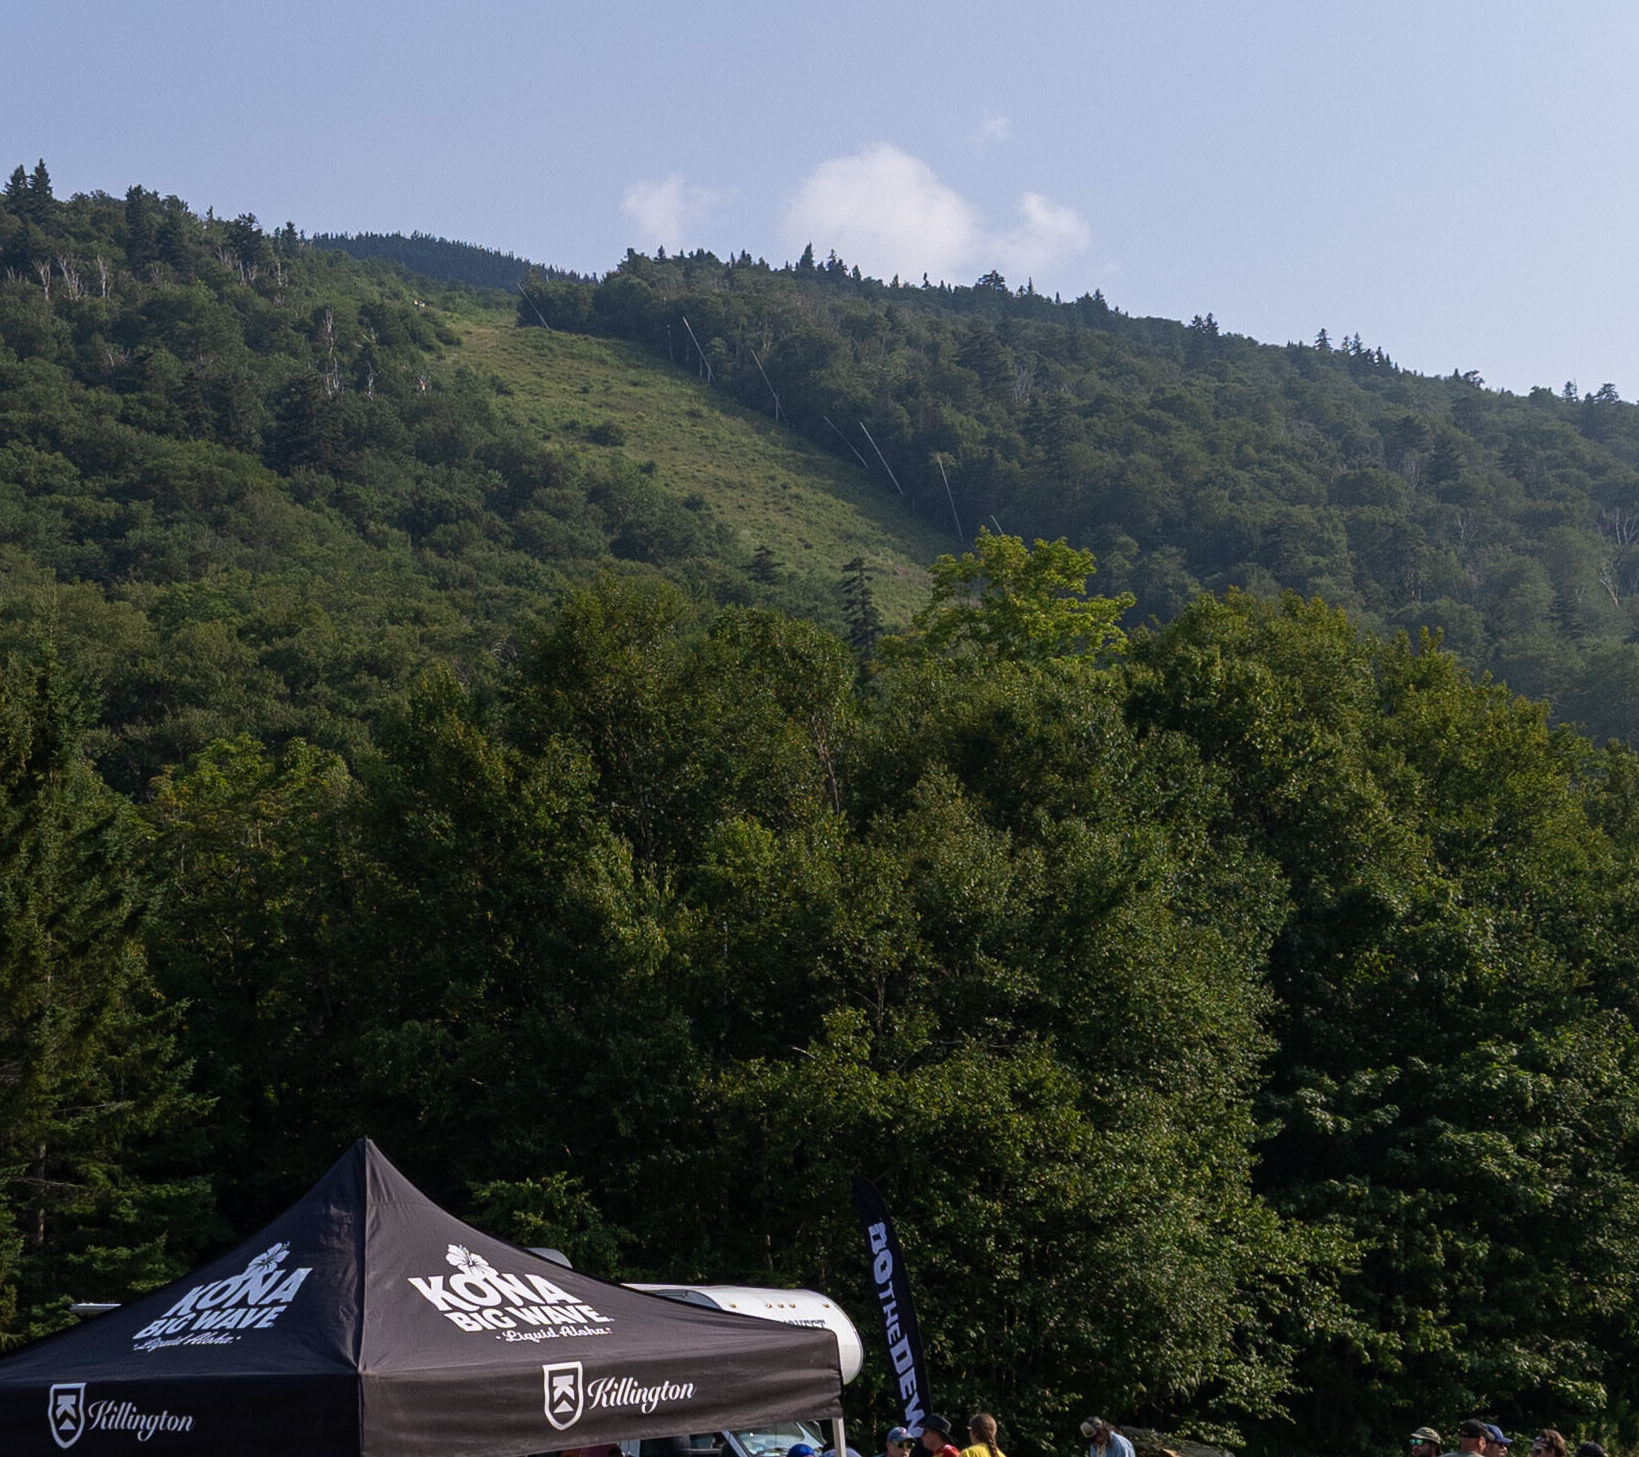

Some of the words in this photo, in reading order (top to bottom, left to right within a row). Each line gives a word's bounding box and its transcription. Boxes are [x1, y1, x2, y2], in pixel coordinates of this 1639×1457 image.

[161, 1267, 313, 1318] KONA
[407, 1272, 582, 1312] KONA
[132, 1312, 197, 1339] BIG
[190, 1305, 287, 1330] WAVE
[444, 1308, 517, 1332] BIG
[505, 1305, 611, 1326] WAVE
[502, 1329, 560, 1343] Liquid
[558, 1325, 606, 1338] Aloha
[587, 1376, 697, 1414] Killington
[88, 1400, 196, 1442] Killington
